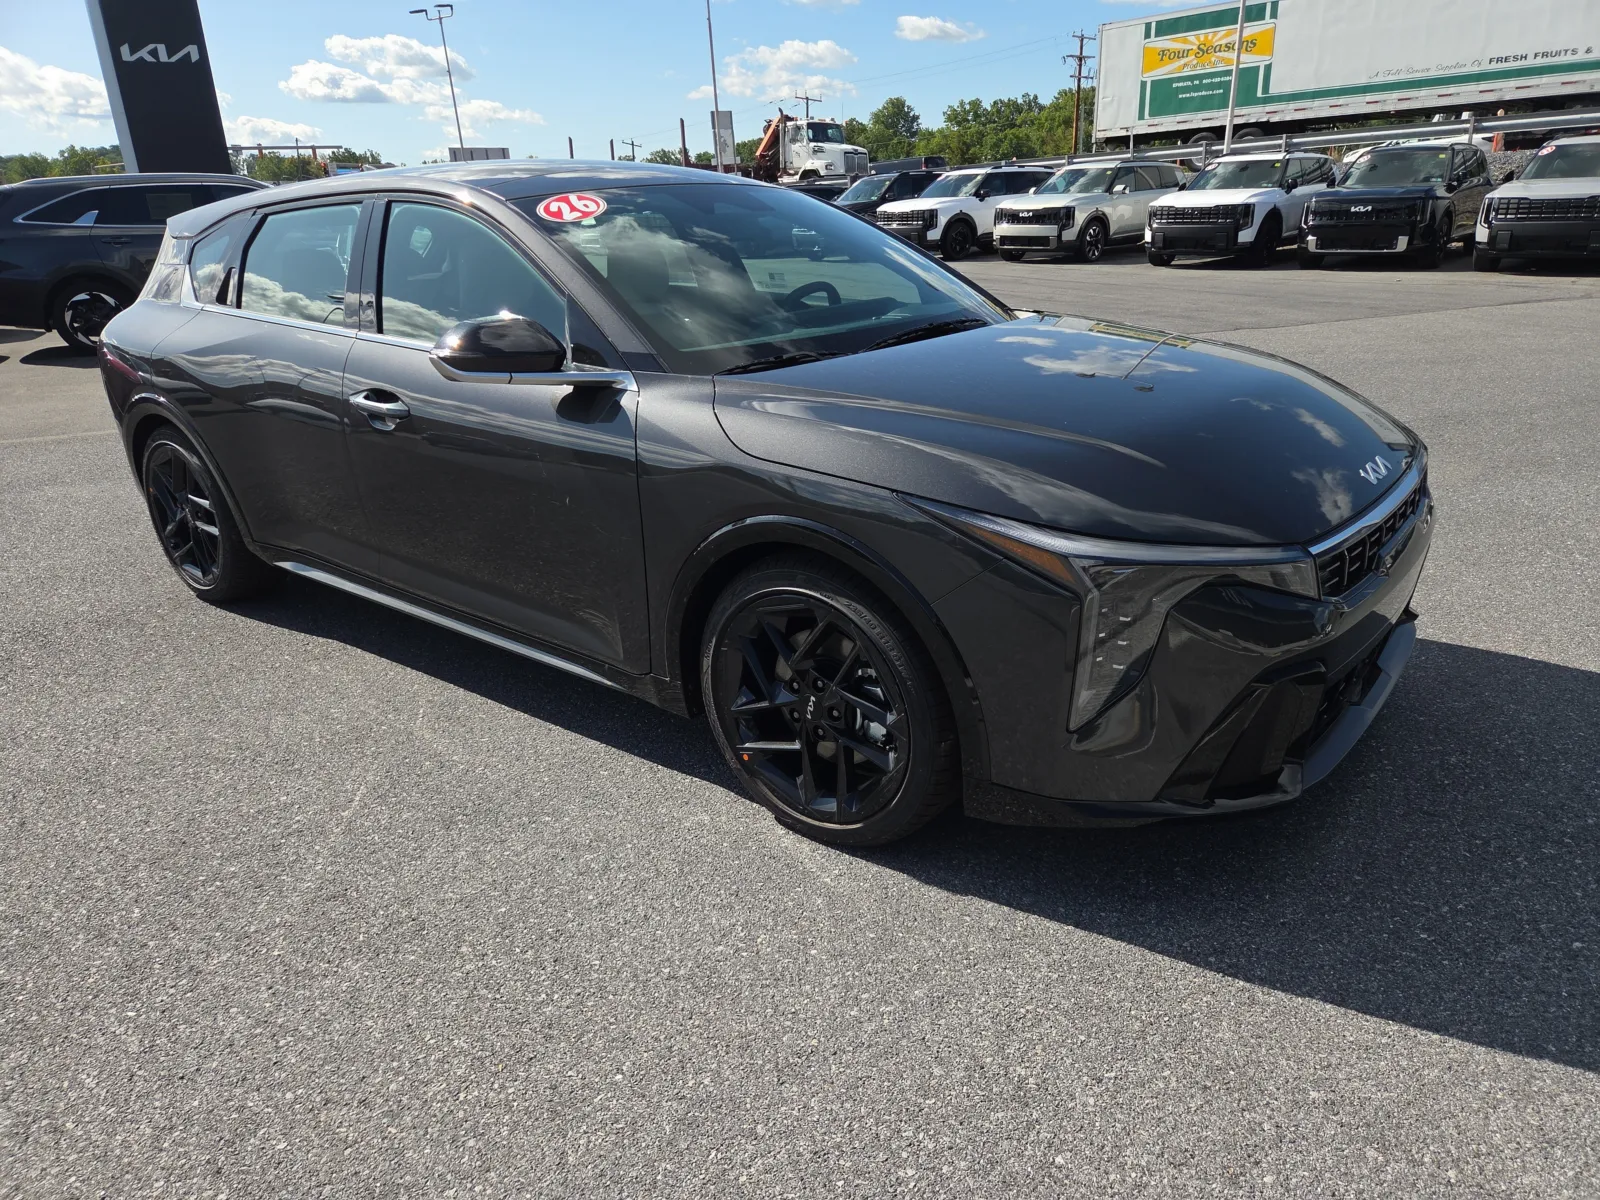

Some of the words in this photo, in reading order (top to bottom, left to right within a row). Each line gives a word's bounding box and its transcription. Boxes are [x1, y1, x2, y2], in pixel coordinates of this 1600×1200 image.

[119, 42, 200, 63] KIA
[1158, 47, 1193, 62] Four
[1194, 38, 1258, 58] Seasons
[1369, 70, 1380, 79] A
[1435, 61, 1467, 73] Supplier
[1471, 58, 1484, 68] Of
[1488, 53, 1528, 64] FRESH
[1533, 48, 1579, 60] FRUITS
[1584, 46, 1593, 54] &
[1182, 61, 1211, 70] Produce
[549, 194, 598, 220] 26
[1359, 455, 1393, 486] KIA
[805, 695, 816, 720] KIA
